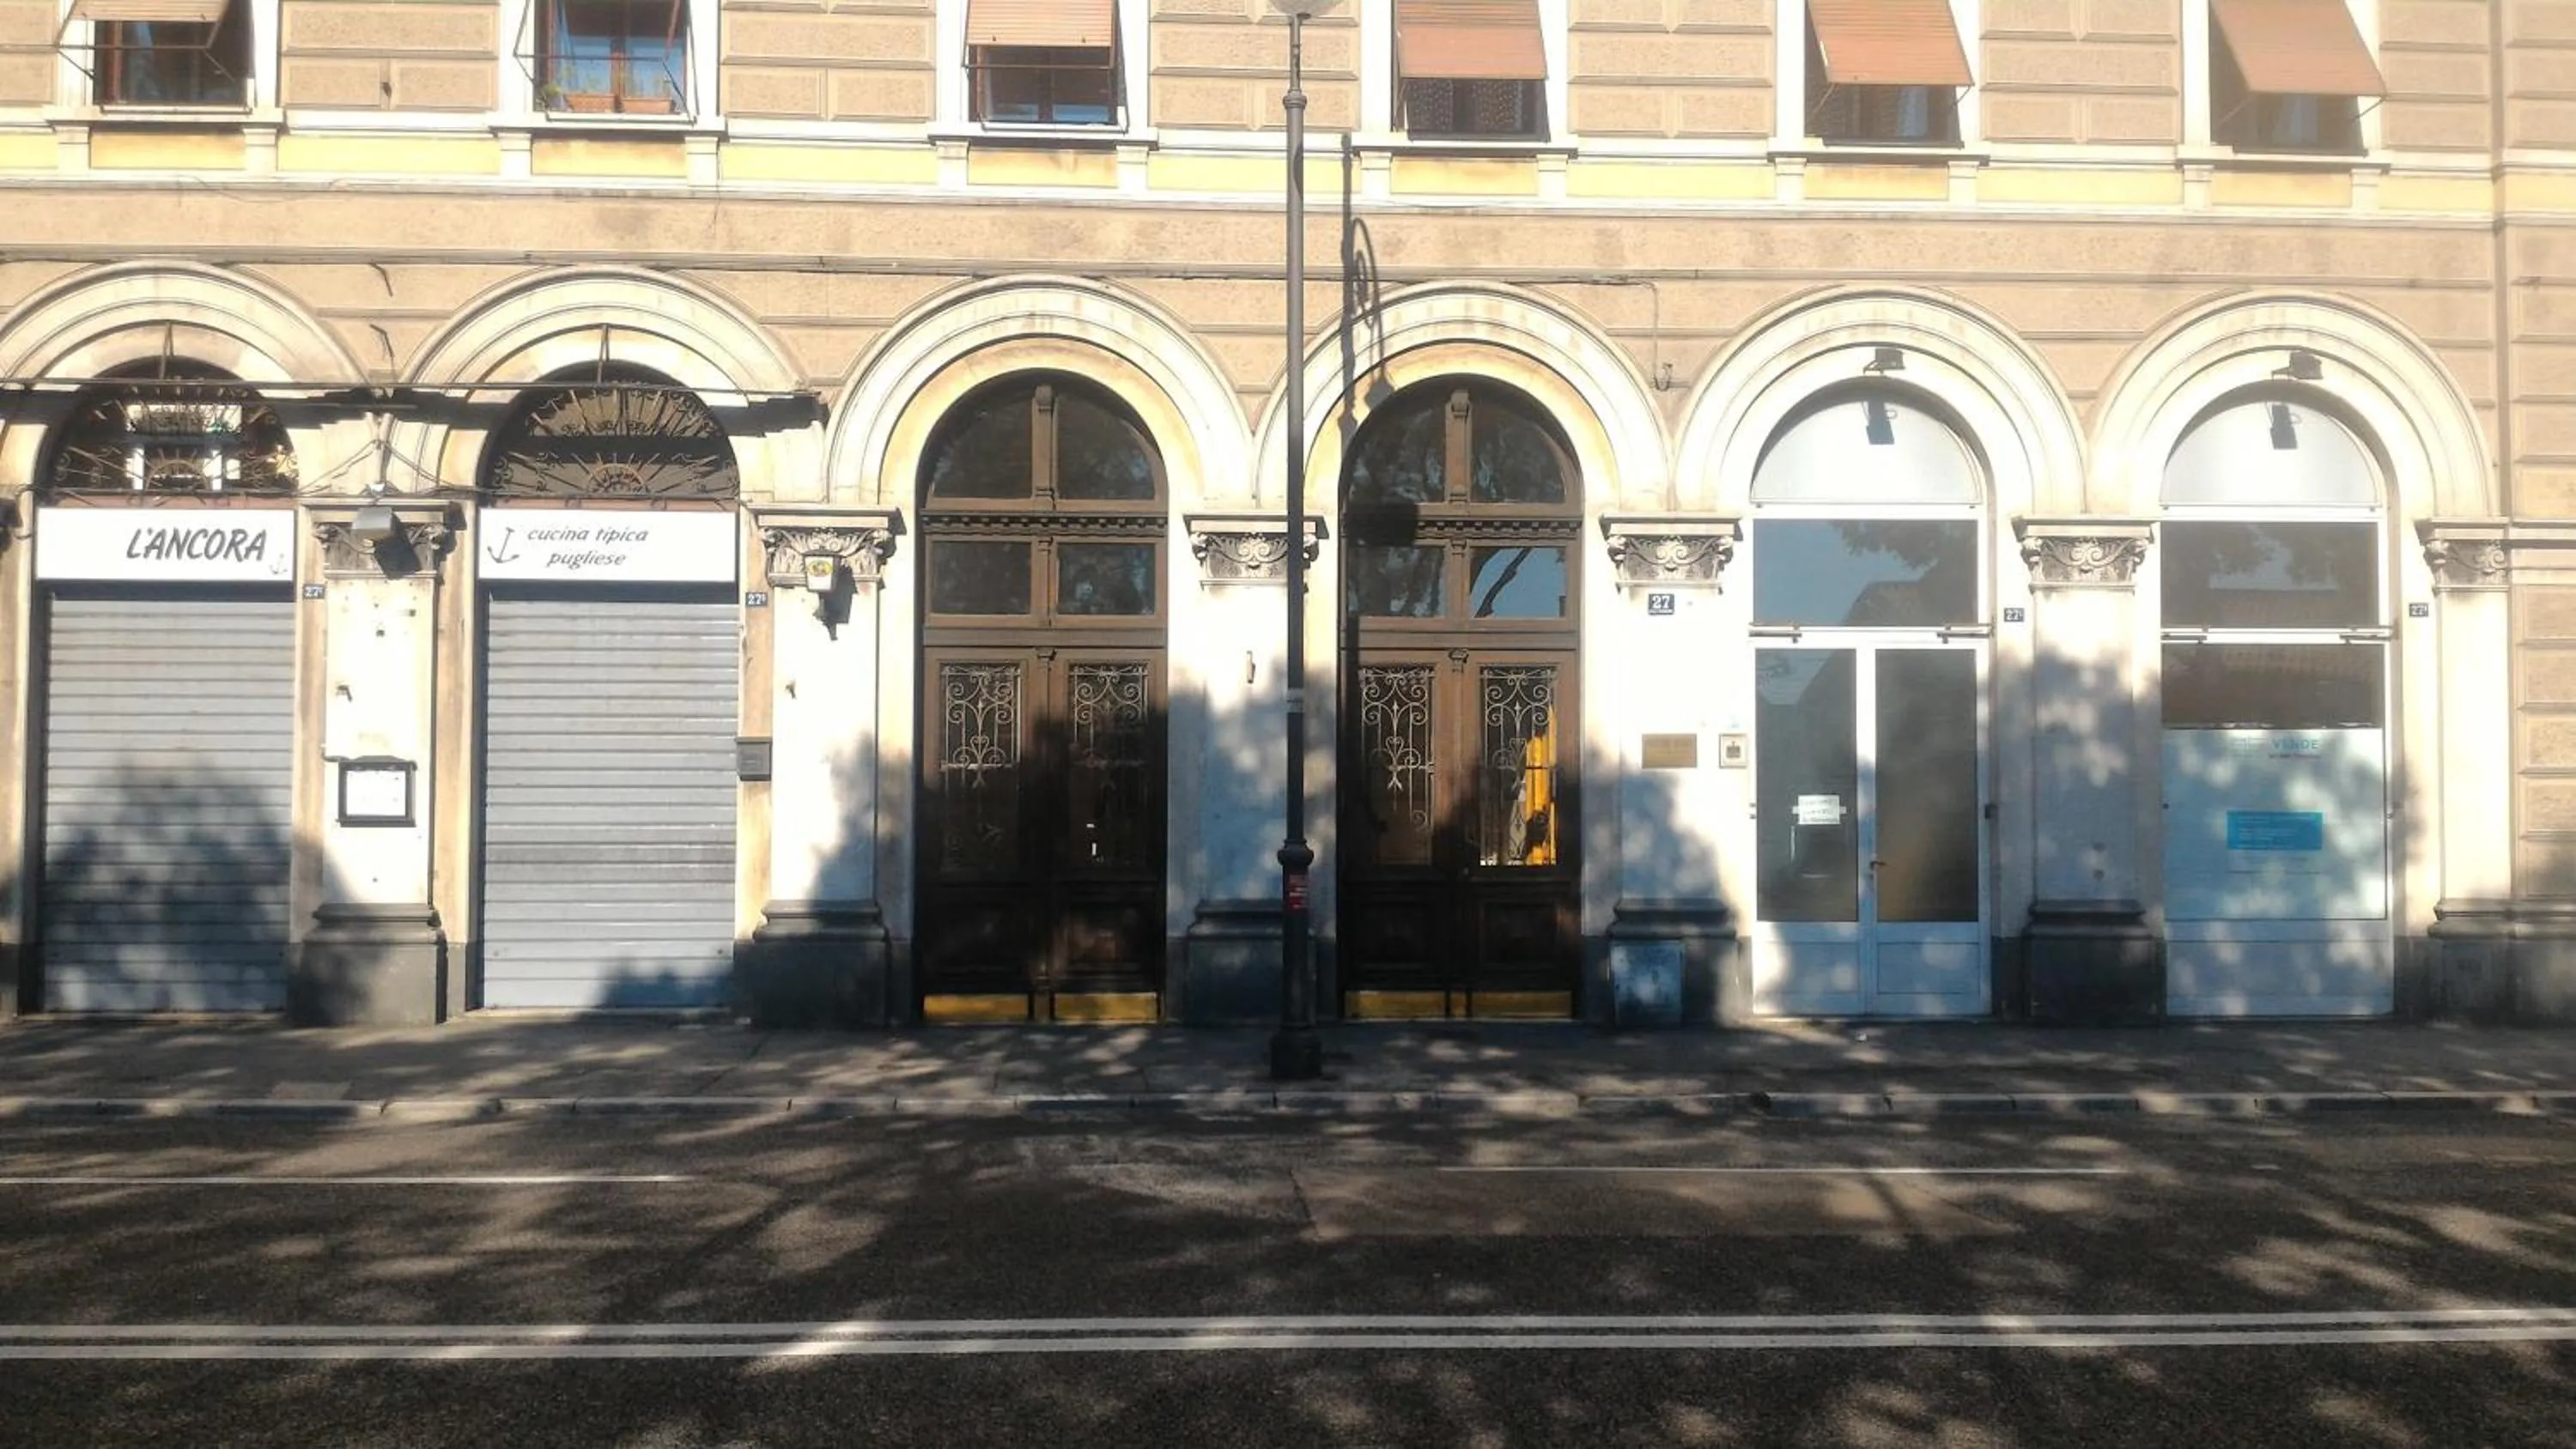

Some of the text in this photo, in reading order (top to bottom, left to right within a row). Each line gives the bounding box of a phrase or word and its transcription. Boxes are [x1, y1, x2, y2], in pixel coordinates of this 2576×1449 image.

[126, 527, 267, 563] L'ANCORA
[527, 526, 649, 545] cucina tipica
[545, 549, 627, 571] pugliese
[1652, 595, 1670, 609] 27
